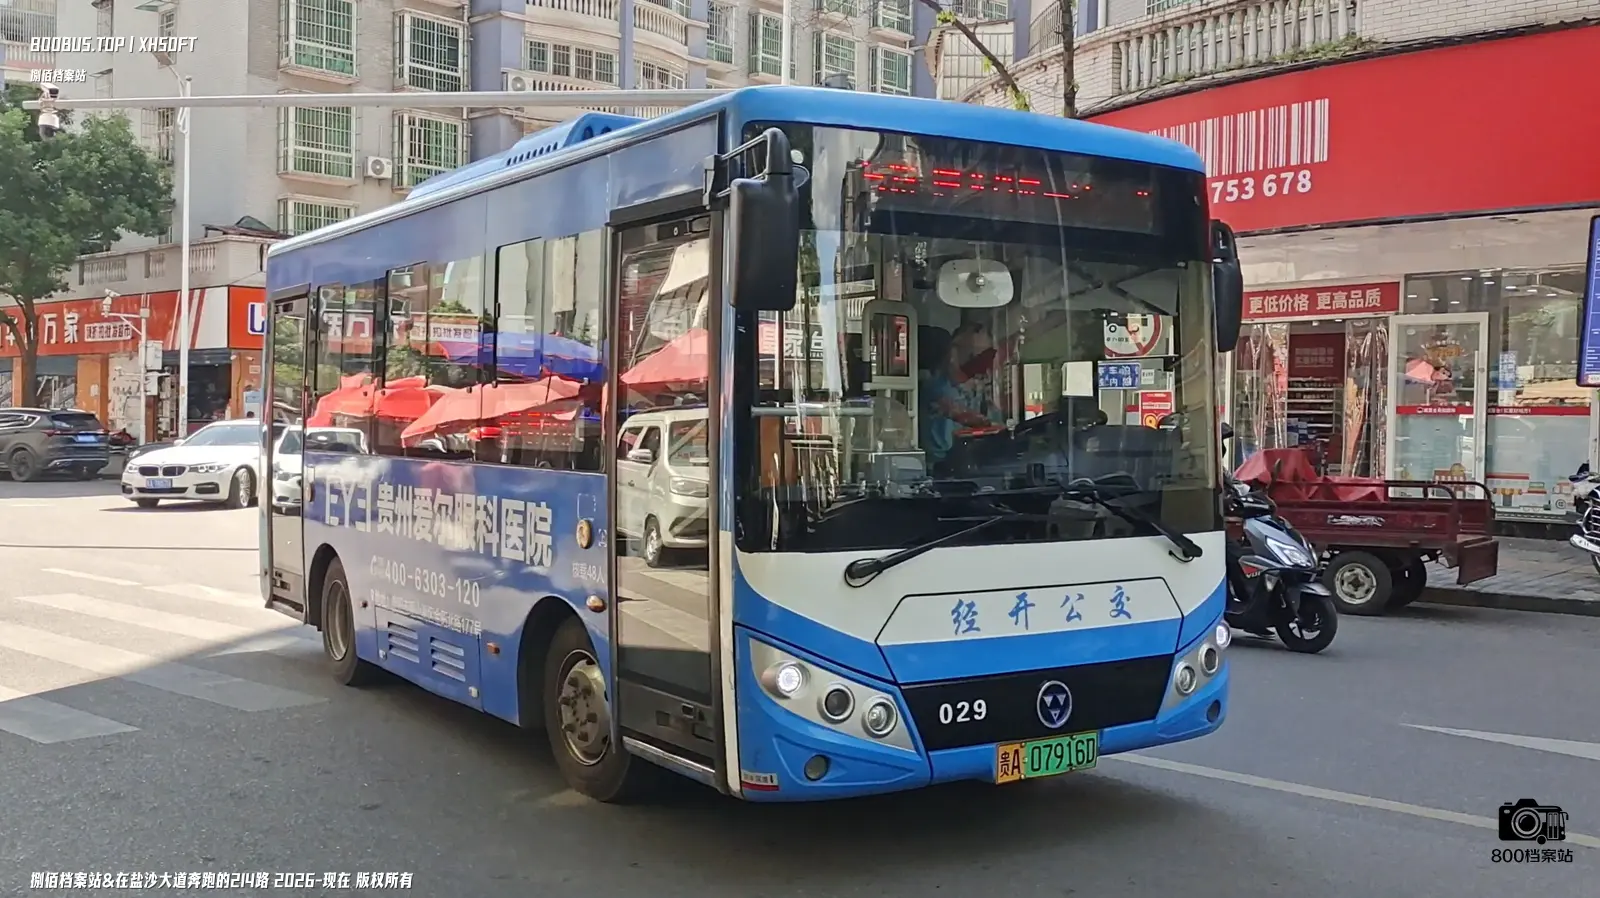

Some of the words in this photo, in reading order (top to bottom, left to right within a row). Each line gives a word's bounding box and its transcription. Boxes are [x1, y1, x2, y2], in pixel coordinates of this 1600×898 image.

[1211, 177, 1255, 204] 753
[1263, 169, 1312, 197] 678
[1249, 293, 1310, 314] 更低价格
[1316, 287, 1381, 310] 更高品质
[377, 482, 552, 568] 贵州爱尔眼科医院
[385, 560, 480, 607] 400-6303-120
[951, 585, 1132, 635] 经开公交
[939, 699, 987, 724] 029
